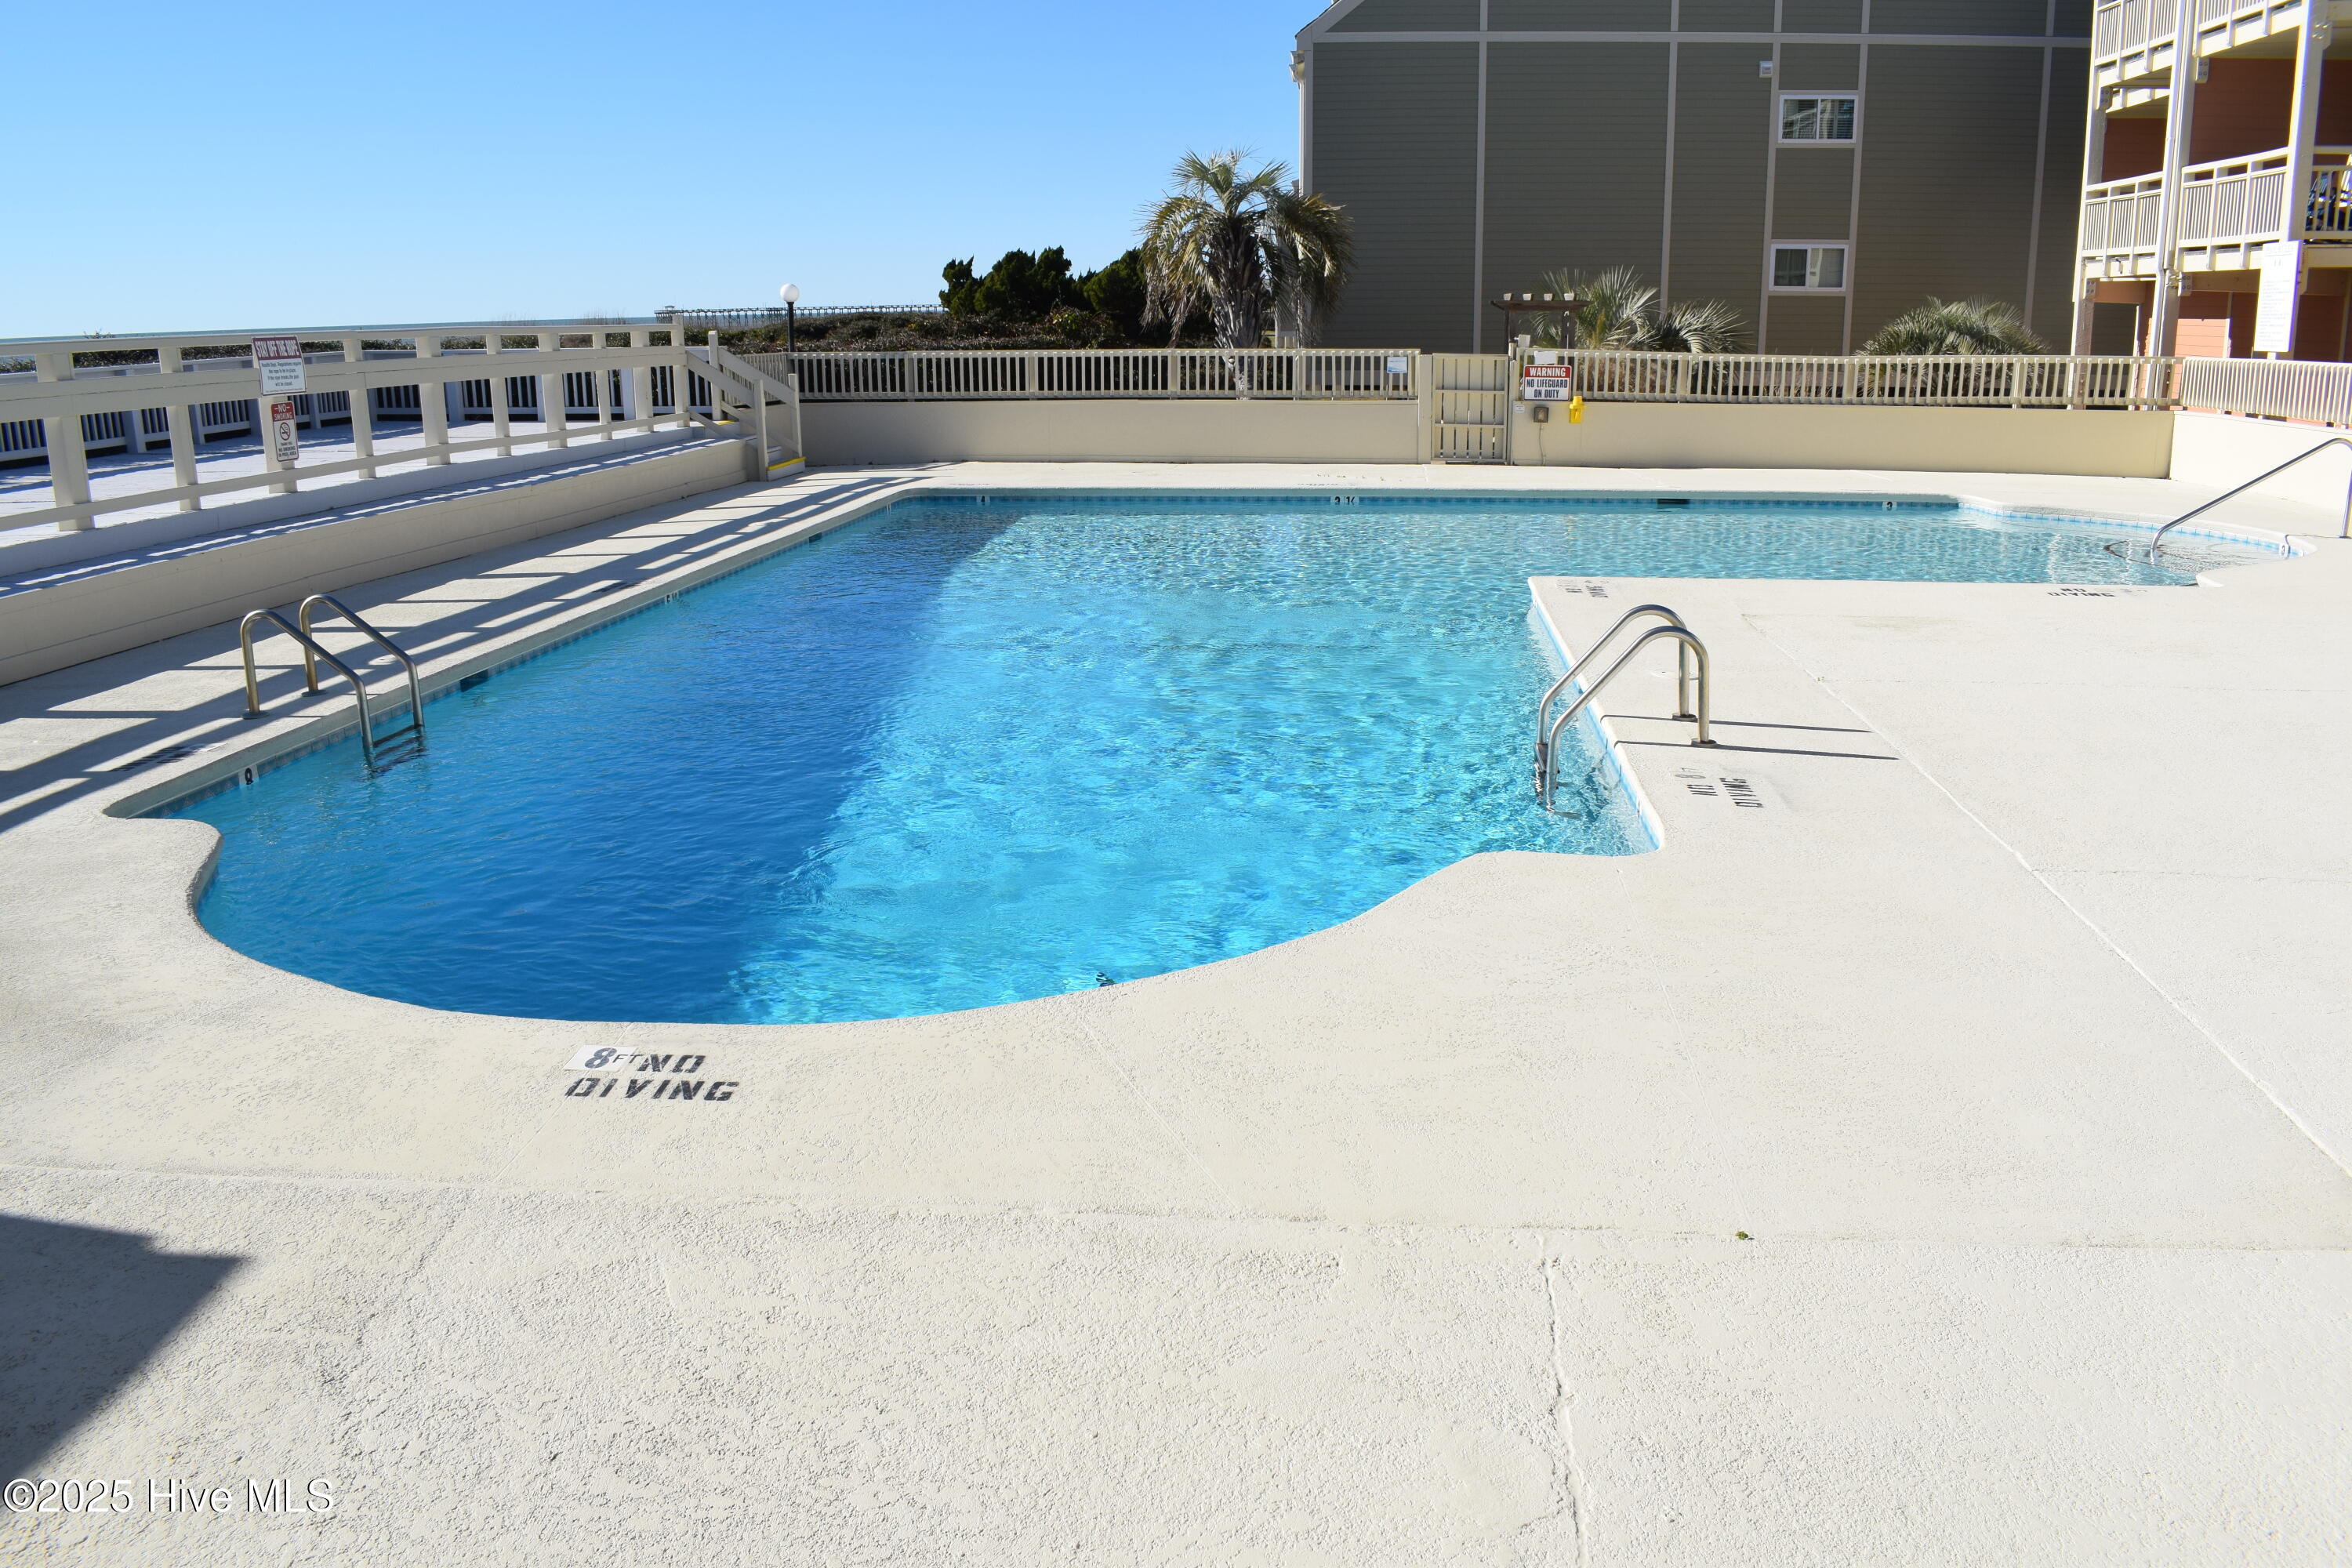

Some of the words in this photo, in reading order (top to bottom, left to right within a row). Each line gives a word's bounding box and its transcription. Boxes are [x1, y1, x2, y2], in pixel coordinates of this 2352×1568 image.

[267, 339, 278, 357] OFF
[1530, 367, 1566, 376] WARNING
[1526, 379, 1535, 388] NO
[1537, 379, 1568, 388] LIFEGUARD
[1534, 389, 1542, 397] ON
[1544, 389, 1559, 397] DUTY
[278, 404, 287, 412] NO
[274, 412, 293, 421] SMOKING
[1719, 777, 1764, 808] DIVING
[637, 1054, 706, 1073] NO
[564, 1077, 739, 1102] DIVING
